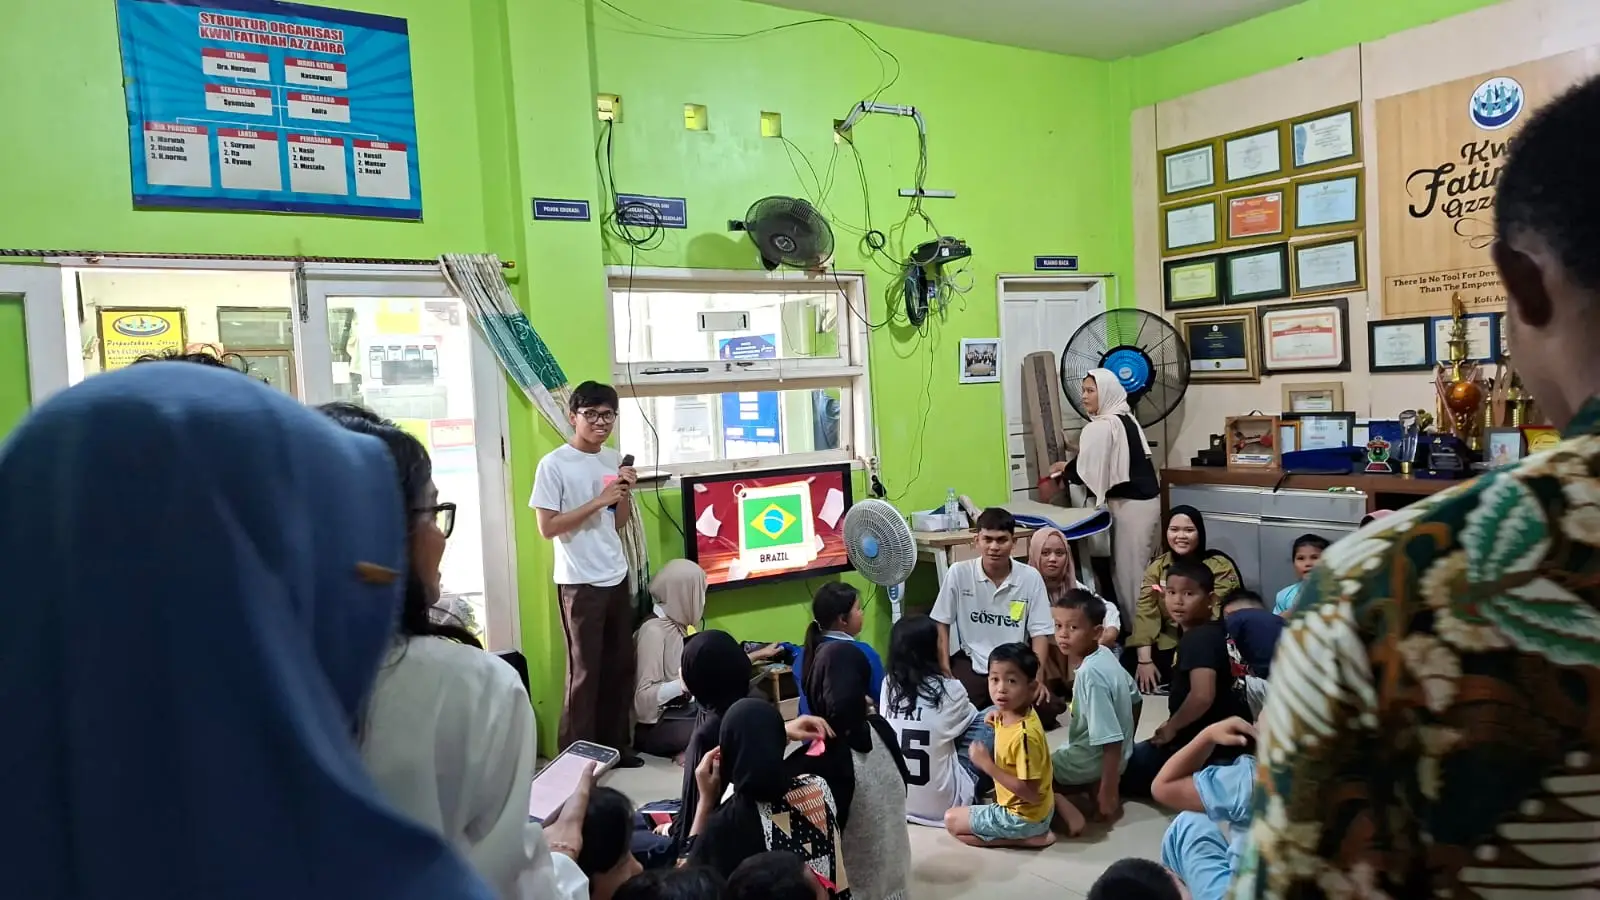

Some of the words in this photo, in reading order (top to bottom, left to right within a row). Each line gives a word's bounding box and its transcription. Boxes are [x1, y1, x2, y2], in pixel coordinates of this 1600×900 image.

[199, 12, 268, 32] STRUKTUR
[269, 20, 344, 42] ORGANISASI
[199, 25, 232, 41] KWN
[233, 30, 287, 48] FATIMAH
[288, 36, 305, 50] AZ
[306, 40, 346, 55] ZAHRA
[220, 86, 257, 96] SEKRETARIS
[301, 94, 335, 104] BENDAHARA
[1461, 138, 1512, 165] Kw
[1405, 162, 1502, 218] Fati
[1393, 278, 1418, 287] There
[1428, 275, 1441, 283] No
[1441, 273, 1460, 281] Tool
[1462, 271, 1477, 279] For
[1479, 269, 1499, 277] Dev
[1419, 285, 1442, 294] Than
[1444, 283, 1460, 292] The
[1461, 280, 1502, 290] Empowe
[1474, 295, 1493, 304] Kofi
[760, 552, 790, 563] BRAZIL
